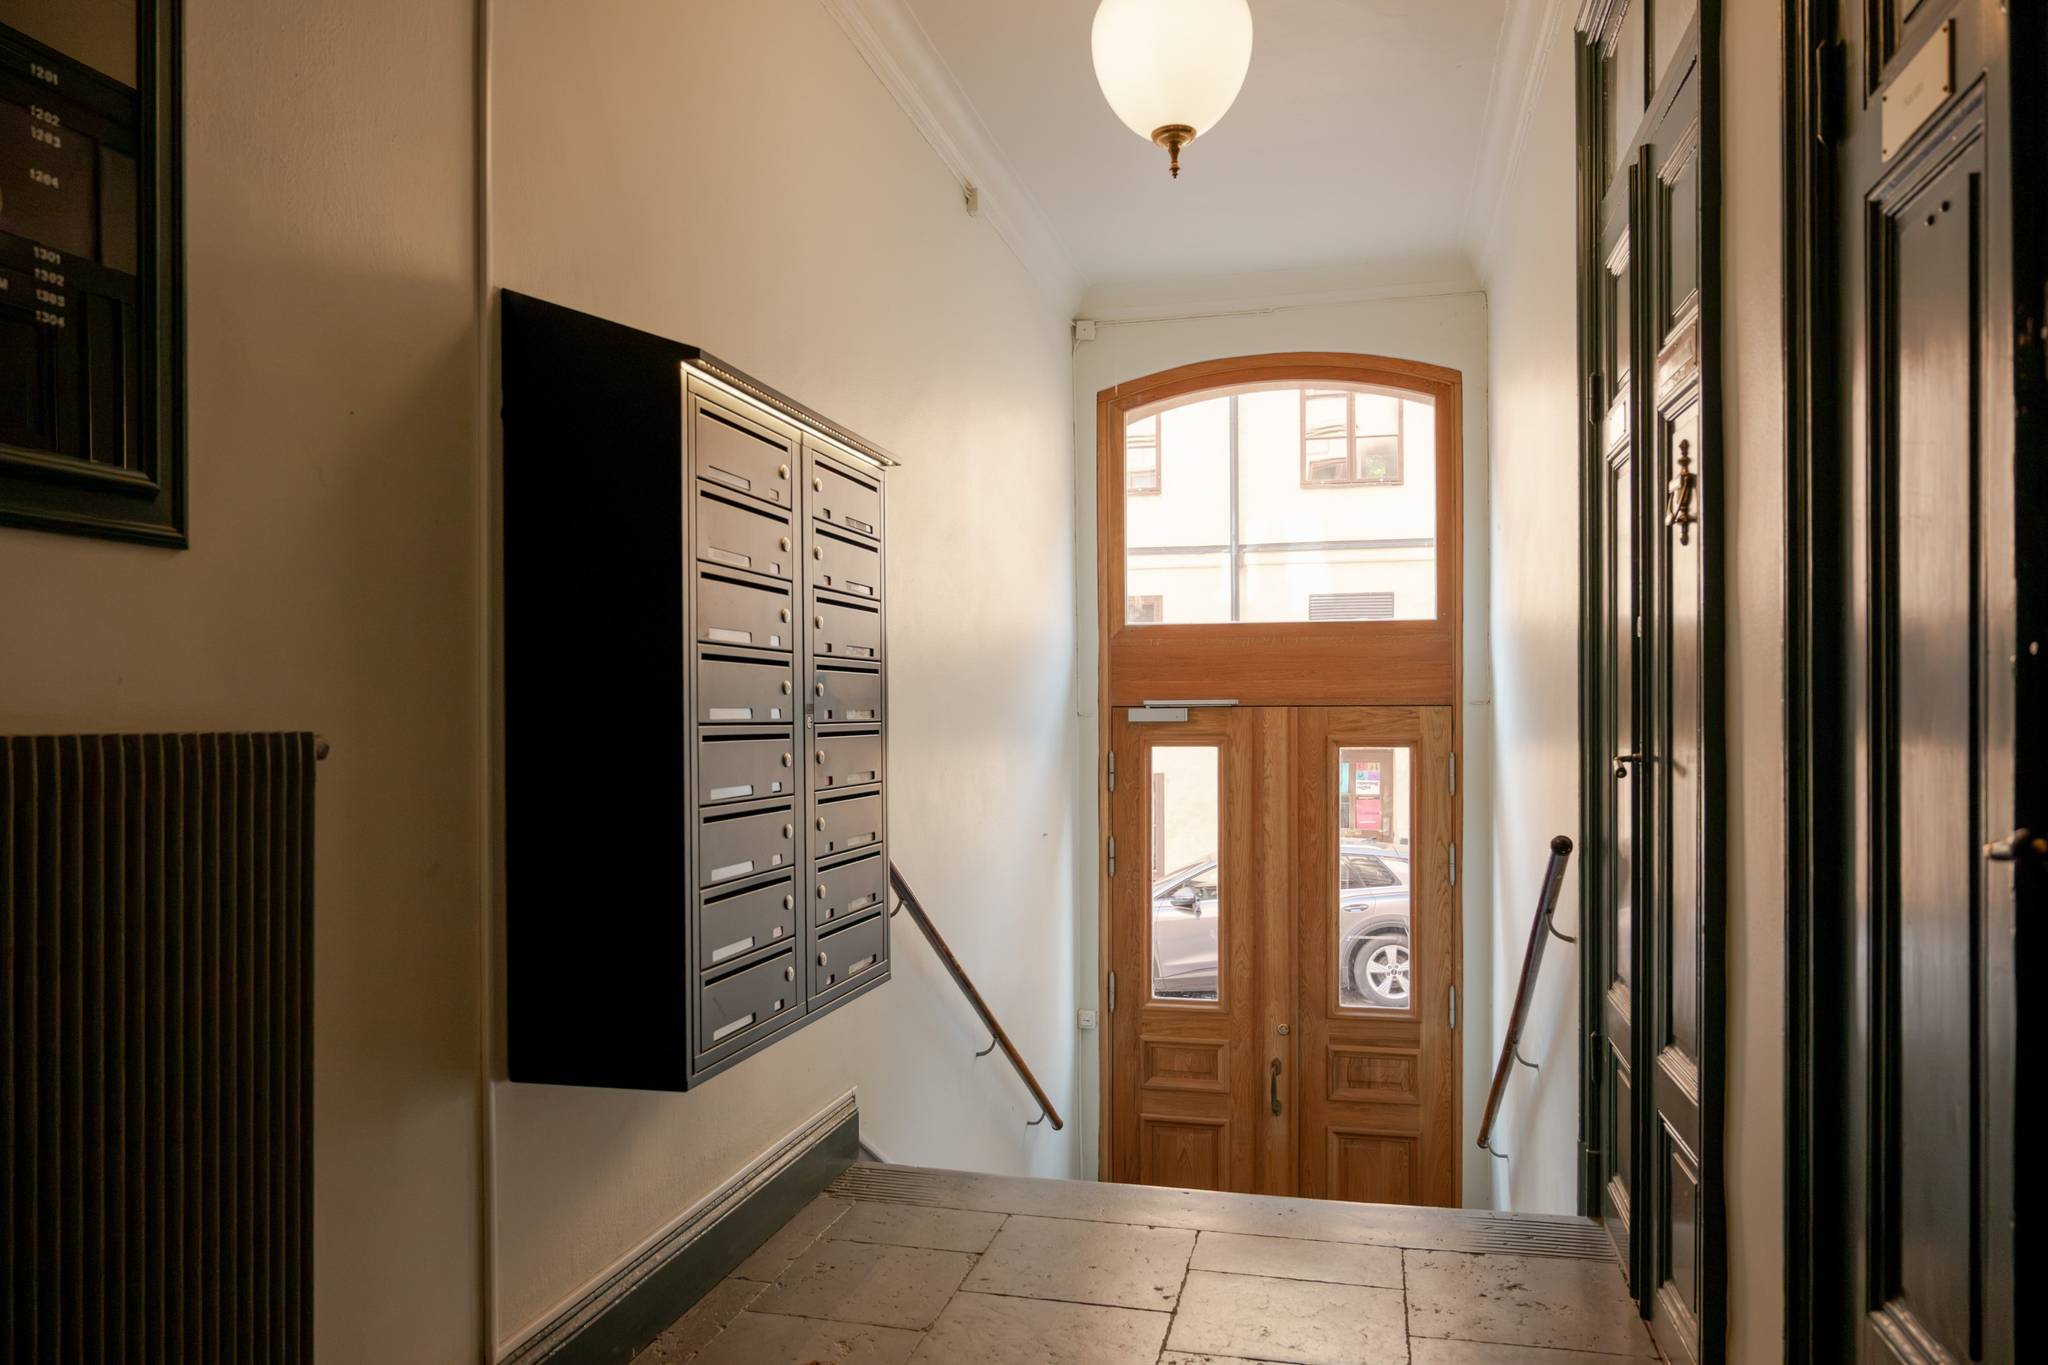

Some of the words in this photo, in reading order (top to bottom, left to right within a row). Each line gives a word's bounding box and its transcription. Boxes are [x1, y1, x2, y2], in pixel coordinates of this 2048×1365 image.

[30, 63, 59, 85] 1201
[30, 104, 60, 126] 1202
[33, 246, 61, 265] 1301
[34, 267, 65, 287] 1302
[35, 310, 65, 328] 1304
